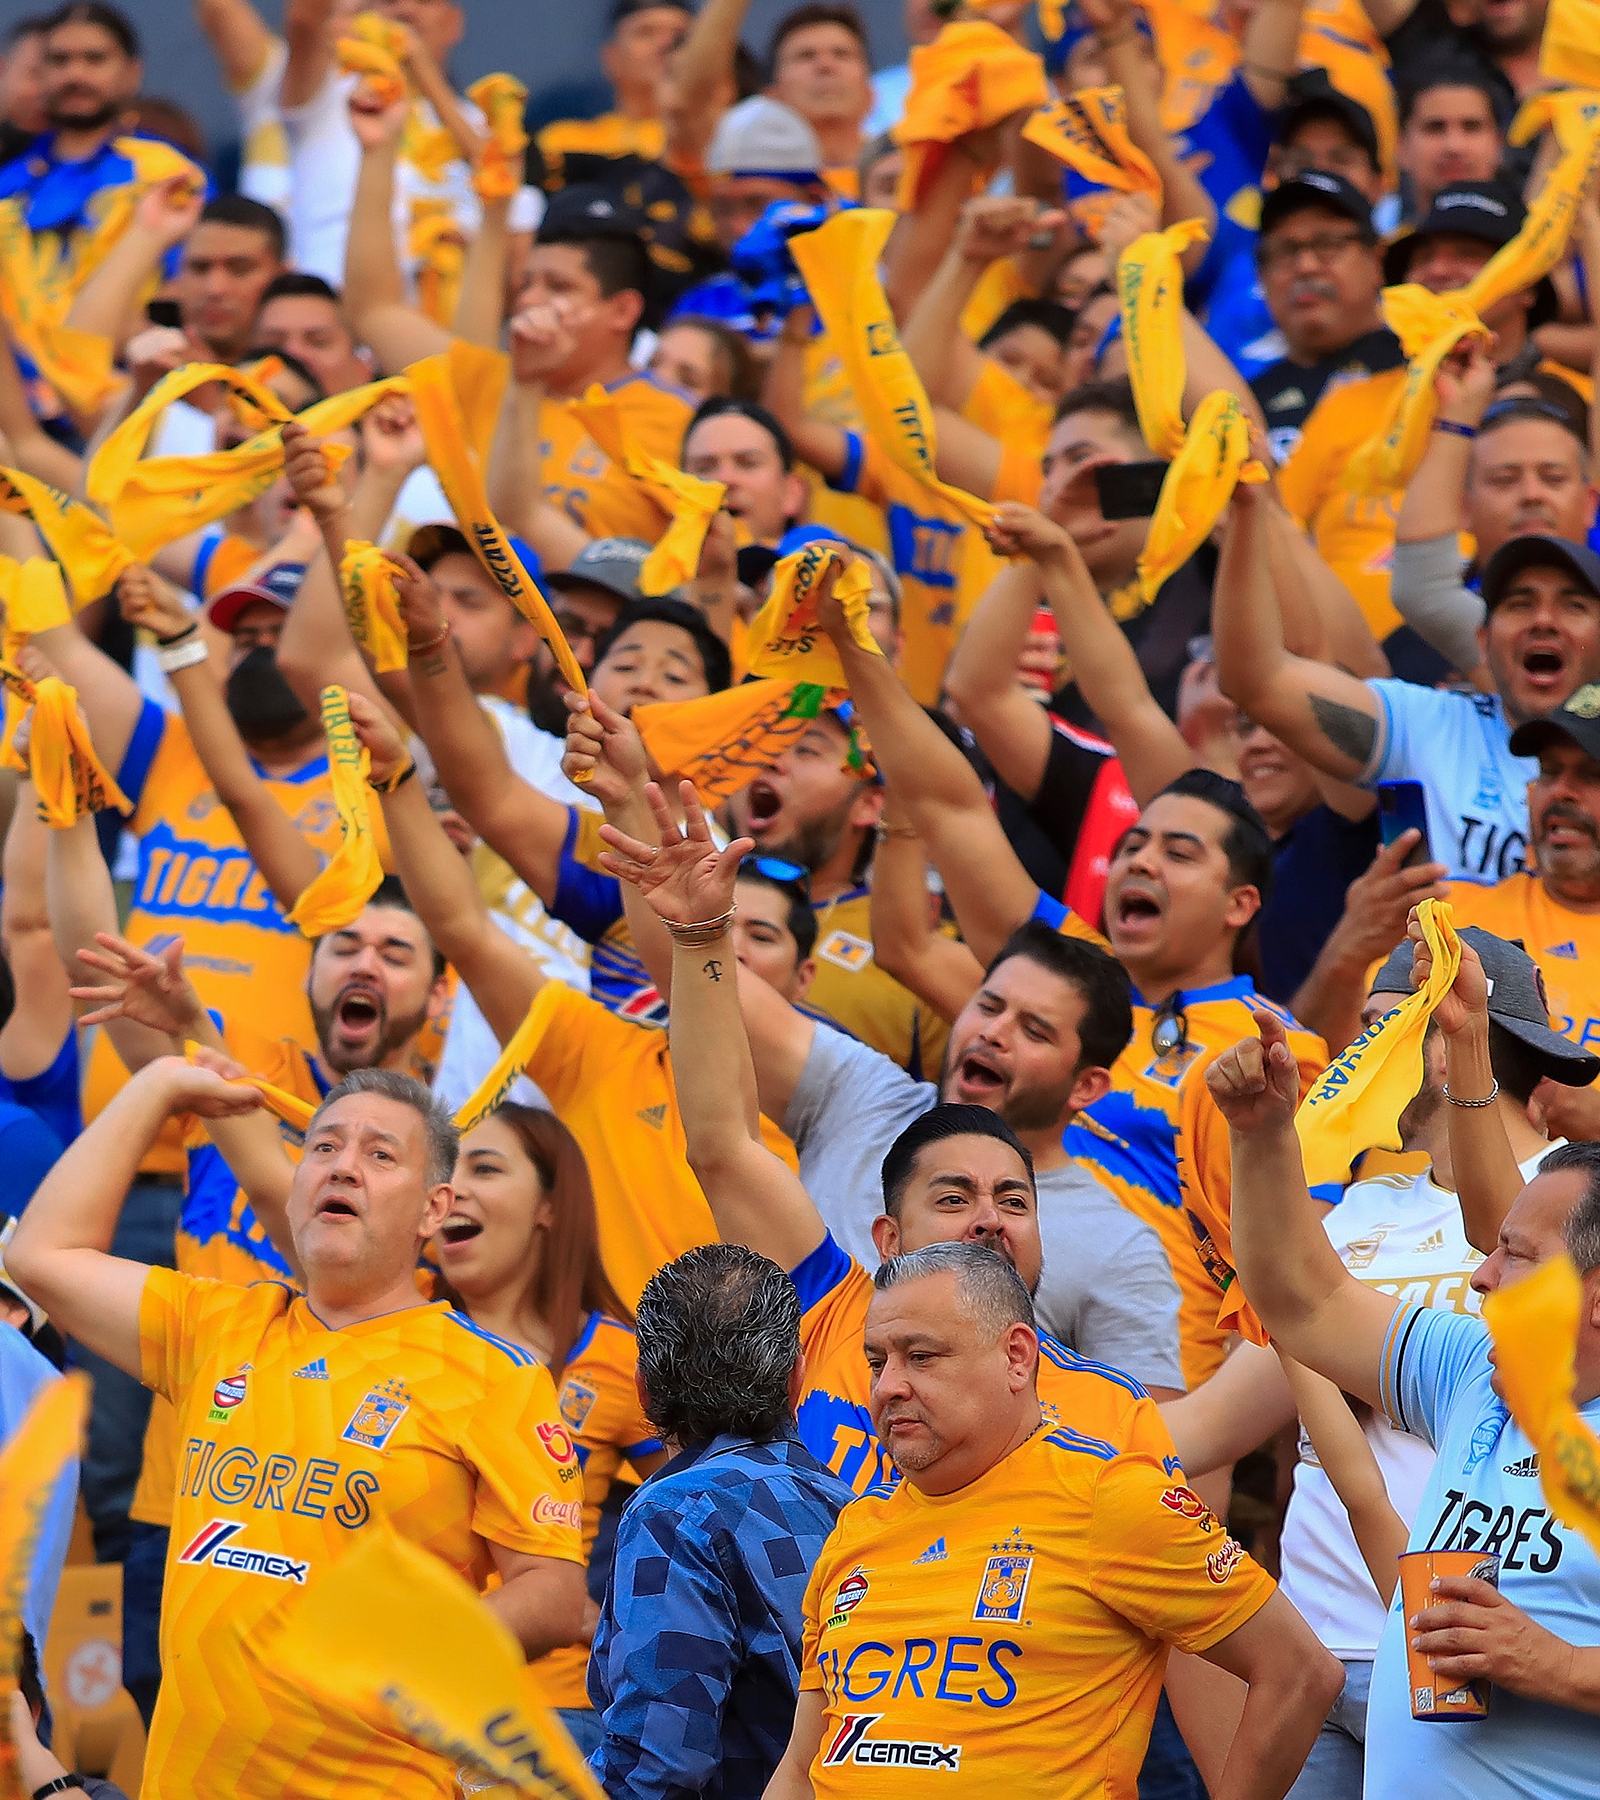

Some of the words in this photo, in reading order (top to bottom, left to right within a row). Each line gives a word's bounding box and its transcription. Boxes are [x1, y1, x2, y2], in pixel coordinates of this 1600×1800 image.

[140, 848, 288, 914] TIGRE
[292, 1370, 330, 1381] adidas
[350, 1431, 375, 1445] UANL
[1502, 1465, 1540, 1478] adidas
[181, 1438, 381, 1530] TIGRES
[213, 1548, 307, 1583] CEMEX
[988, 1557, 1031, 1569] TIGRES
[983, 1607, 1011, 1619] UANL
[817, 1636, 1024, 1709] TIGRES
[854, 1742, 959, 1769] CEMEX
